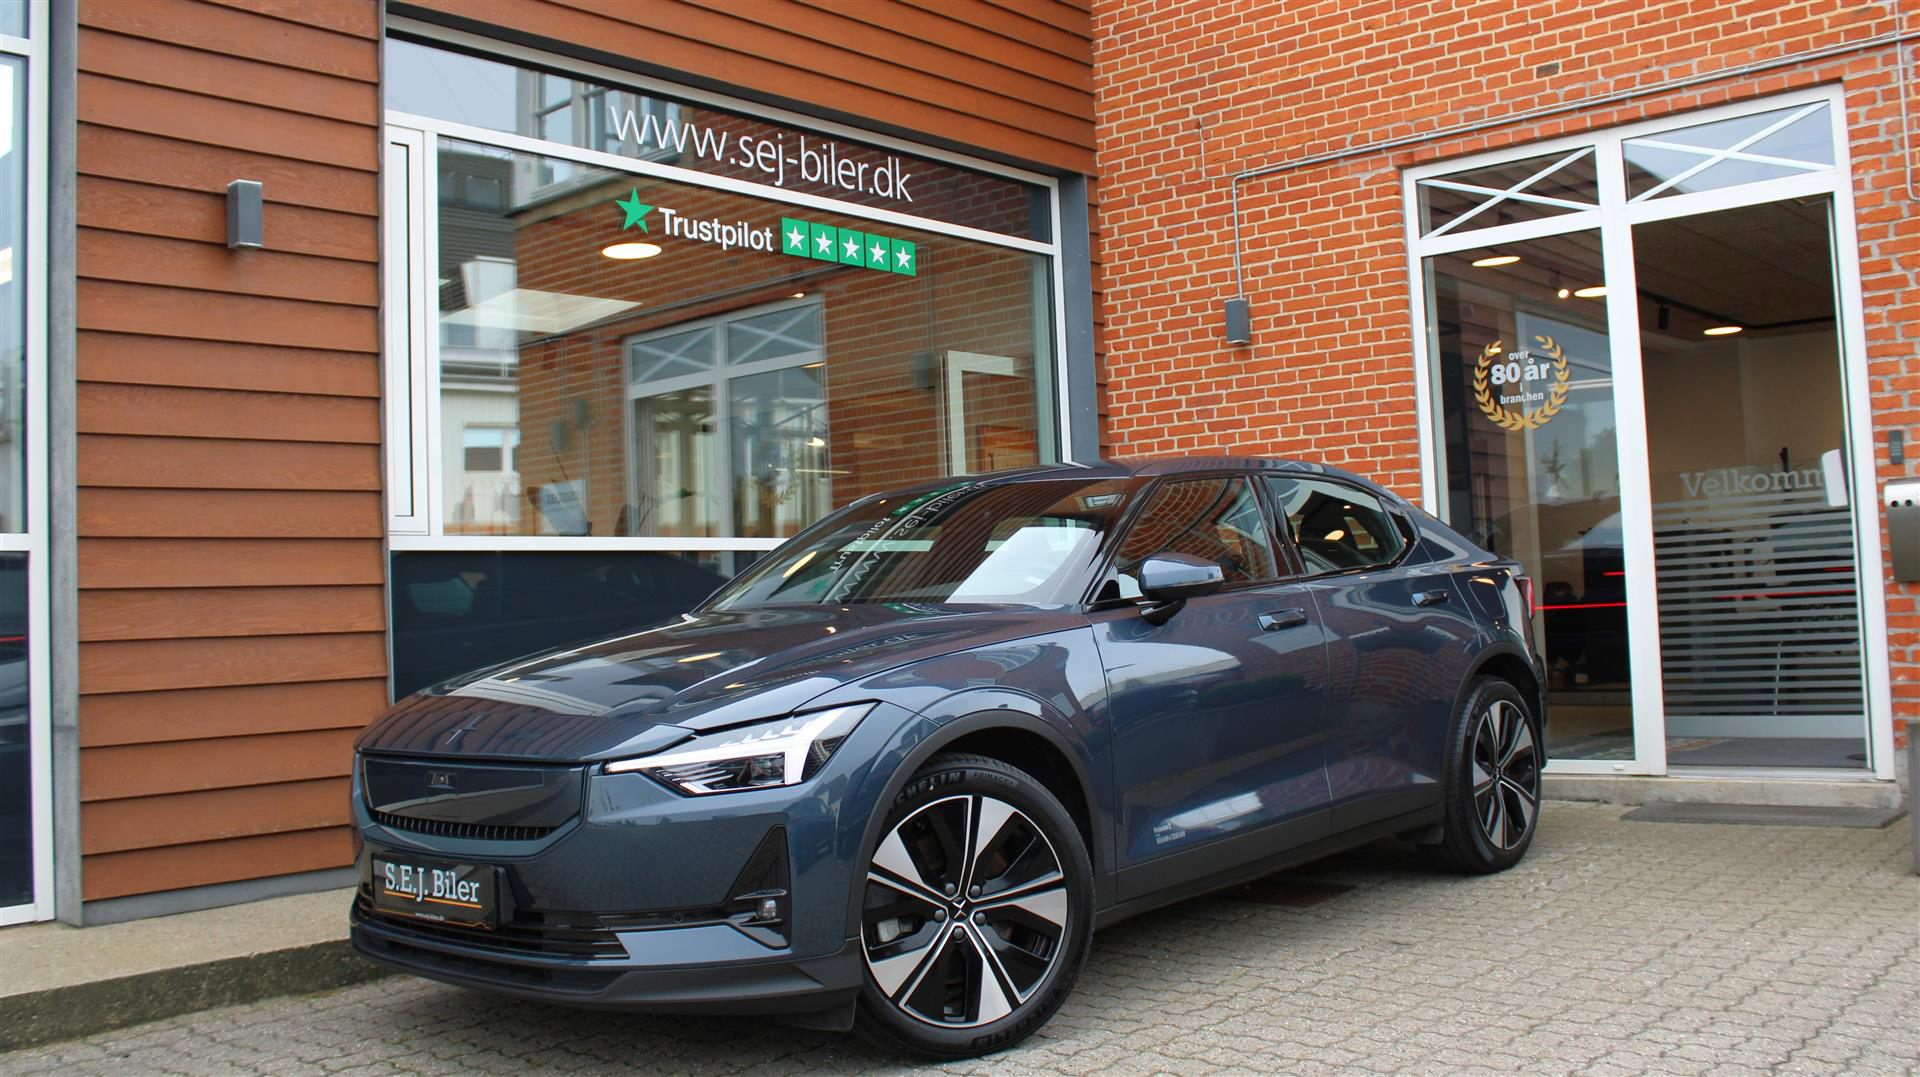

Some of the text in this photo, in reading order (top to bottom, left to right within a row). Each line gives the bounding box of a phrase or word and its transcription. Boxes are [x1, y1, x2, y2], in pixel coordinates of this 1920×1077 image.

[610, 105, 913, 202] www.sej-biler.dk
[658, 207, 773, 252] Trustpilot
[1508, 351, 1530, 361] over
[1491, 358, 1550, 385] 80 år
[1500, 392, 1544, 405] branchen
[1680, 467, 1825, 497] Velkomm
[385, 862, 480, 902] S.E.J. Biler
